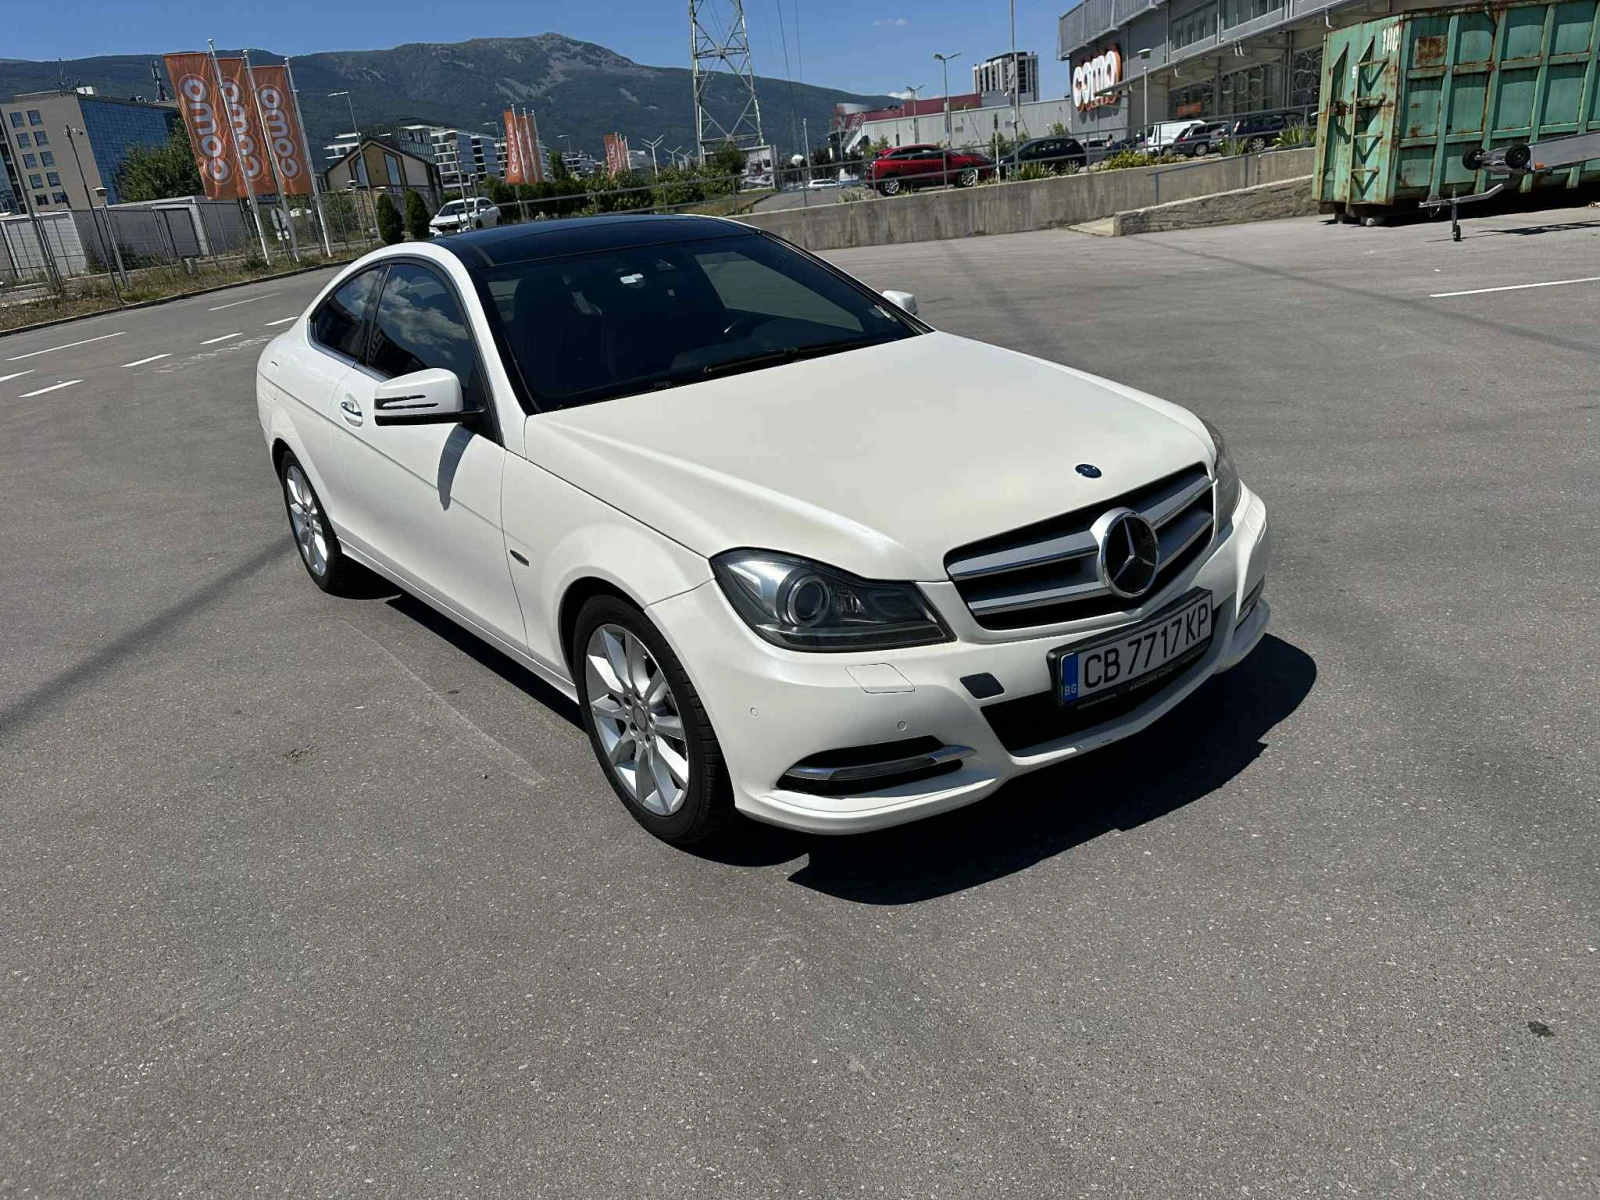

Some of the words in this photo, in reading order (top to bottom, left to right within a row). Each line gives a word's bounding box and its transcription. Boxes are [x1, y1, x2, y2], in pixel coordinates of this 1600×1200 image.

[1084, 647, 1121, 689] CB
[1127, 617, 1182, 675] 7717
[1185, 603, 1208, 645] KP
[1064, 683, 1077, 696] BG
